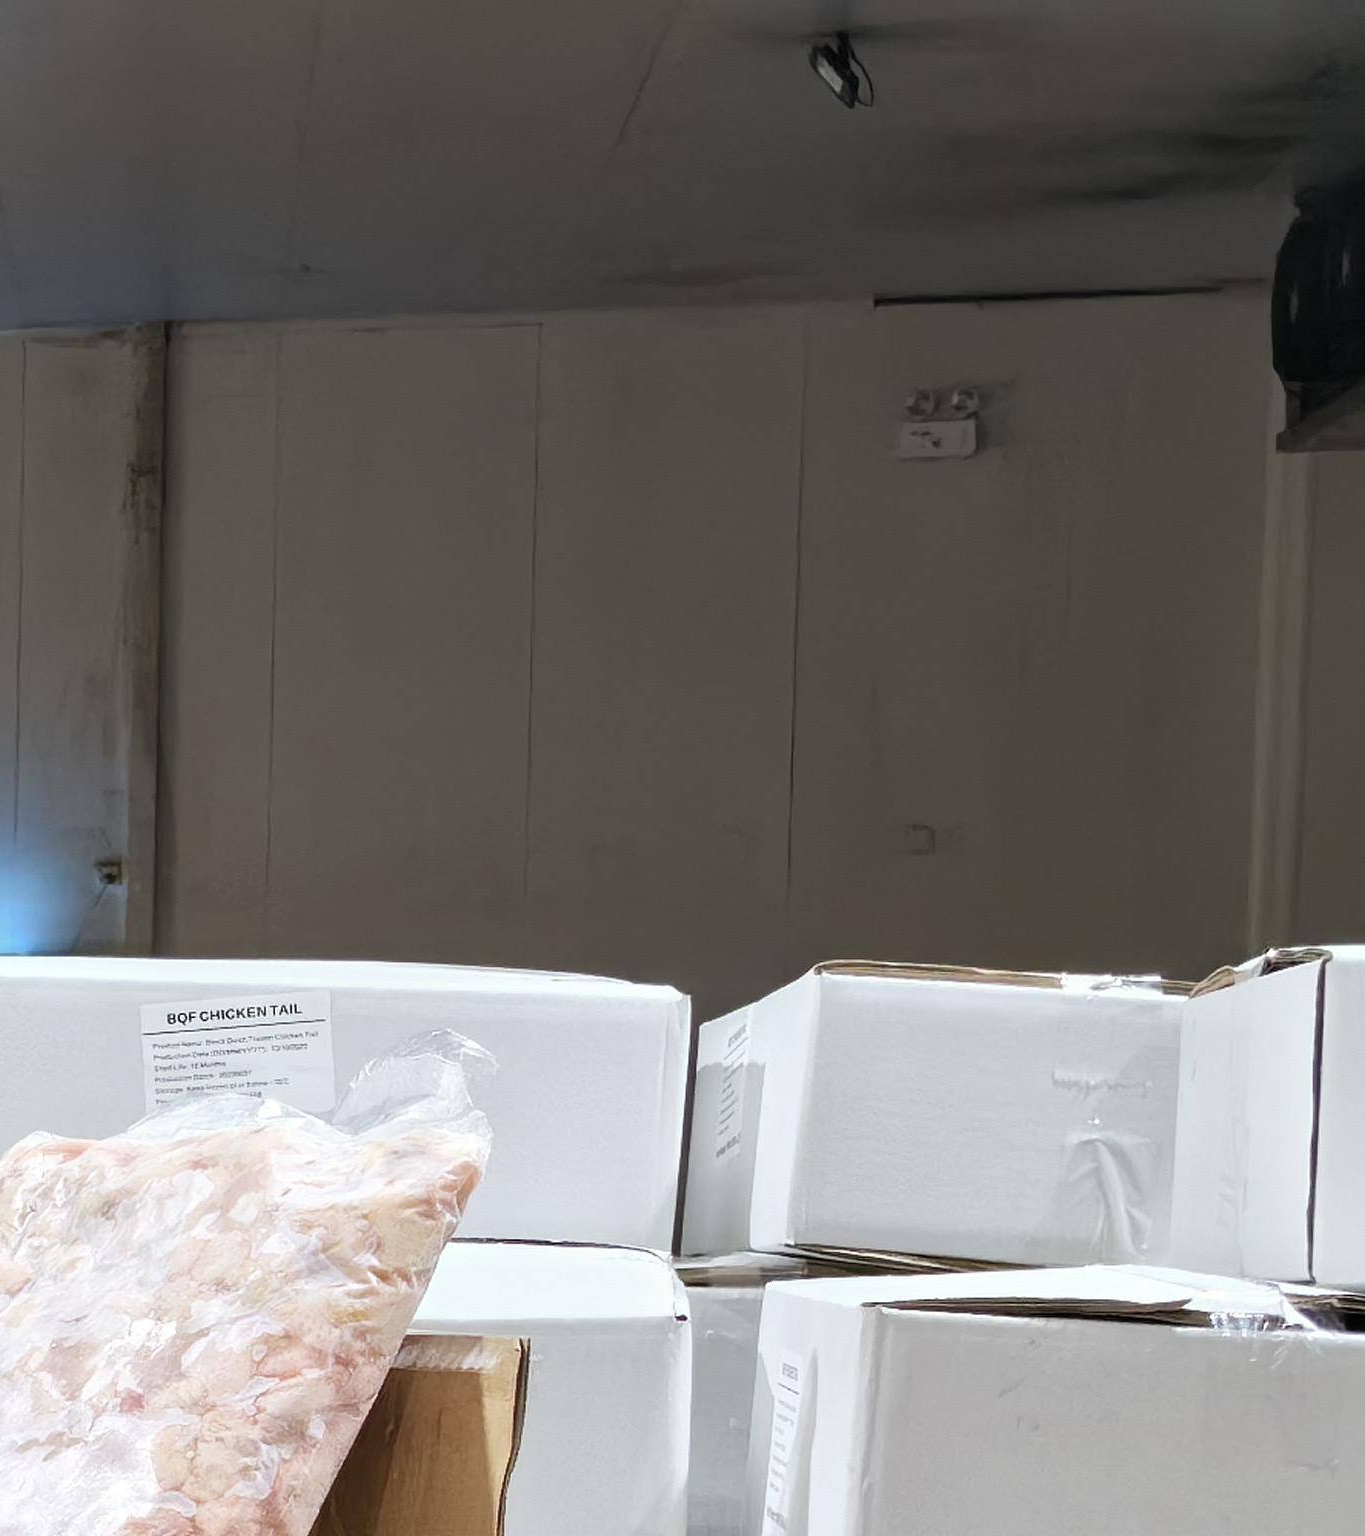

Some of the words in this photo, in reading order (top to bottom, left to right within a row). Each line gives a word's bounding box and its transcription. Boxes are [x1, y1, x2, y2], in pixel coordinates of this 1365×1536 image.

[167, 1011, 196, 1026] BQF
[199, 1005, 266, 1022] CHICKEN
[269, 1002, 302, 1016] TAIL
